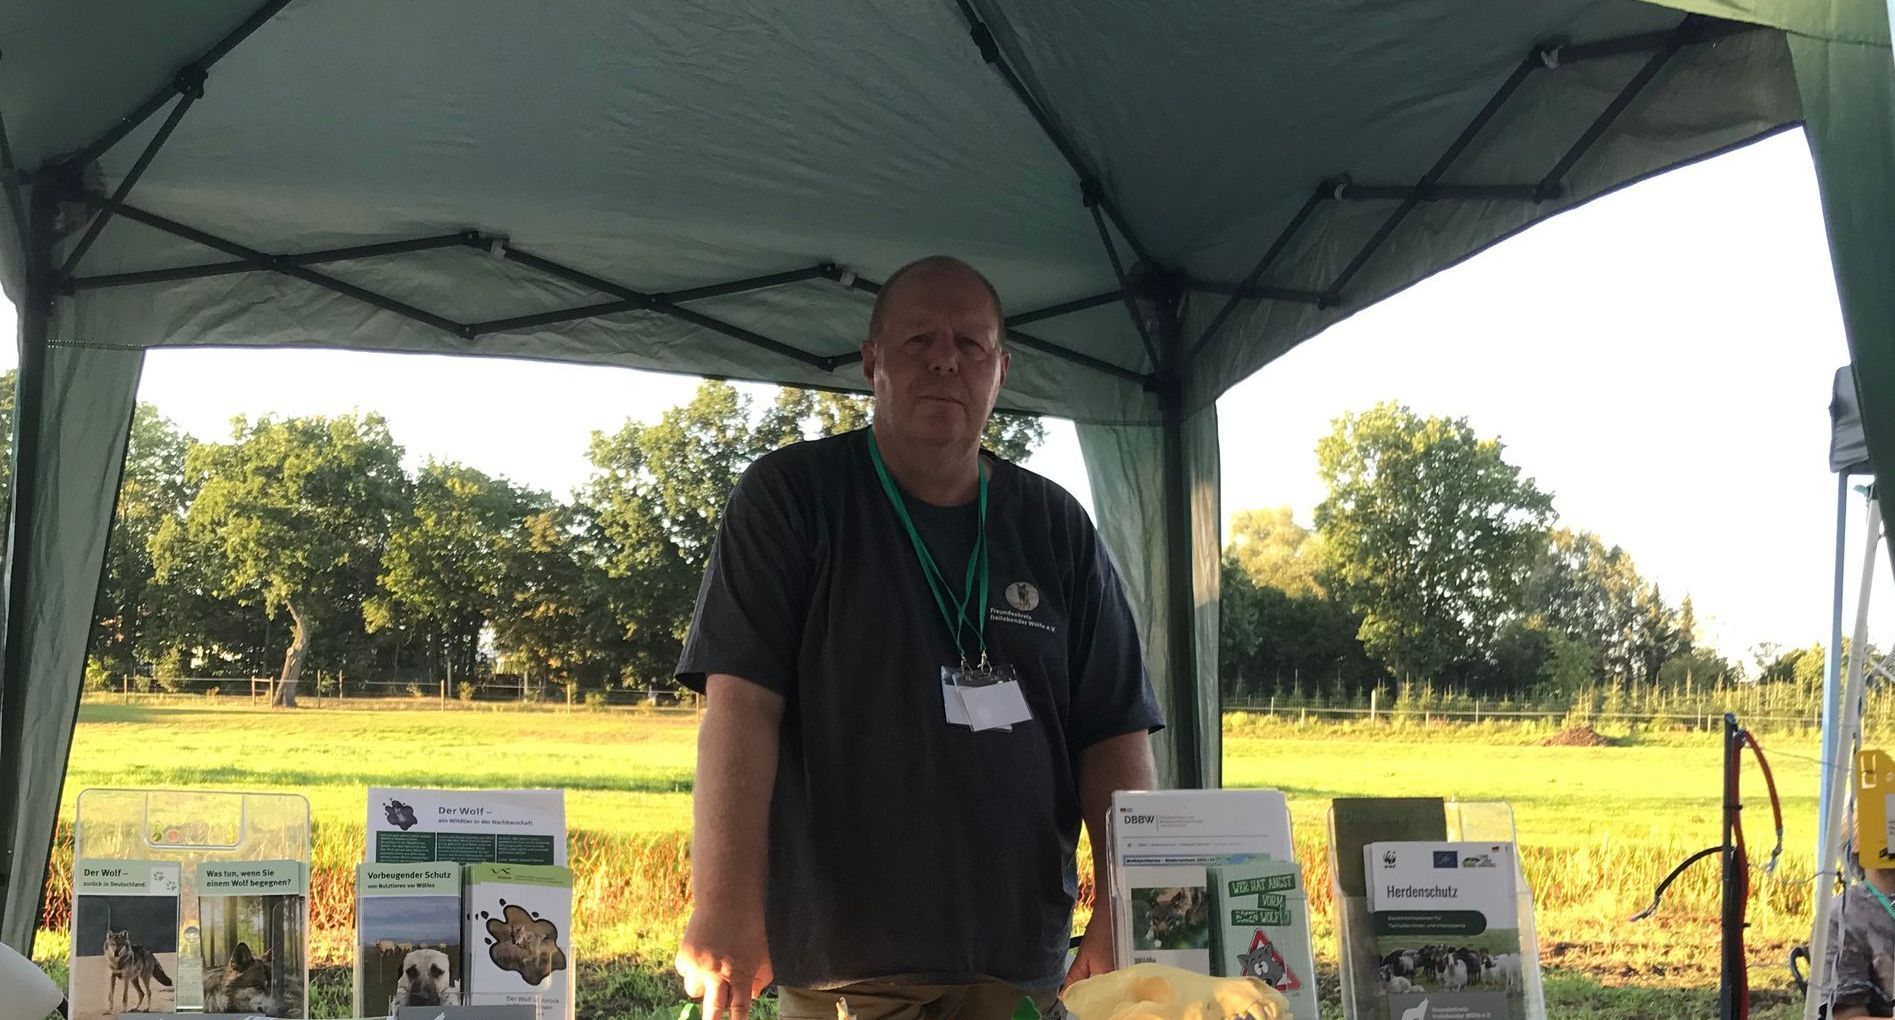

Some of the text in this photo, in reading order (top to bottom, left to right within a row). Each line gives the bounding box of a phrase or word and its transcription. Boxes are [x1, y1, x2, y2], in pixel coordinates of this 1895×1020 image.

[990, 607, 1032, 620] Freundeskreis
[990, 614, 1027, 626] freilebender
[438, 806, 457, 815] Der
[459, 807, 485, 816] Wolf
[1124, 815, 1155, 825] DBBW
[84, 868, 100, 877] Der
[101, 868, 122, 877] Wolf
[206, 870, 222, 878] Was
[223, 870, 239, 878] tun,
[262, 869, 275, 877] Sie
[367, 871, 452, 880] Vorbeugender Schutz
[206, 880, 230, 888] einem
[250, 879, 292, 888] begegnen?
[1386, 885, 1459, 898] Herdenschutz
